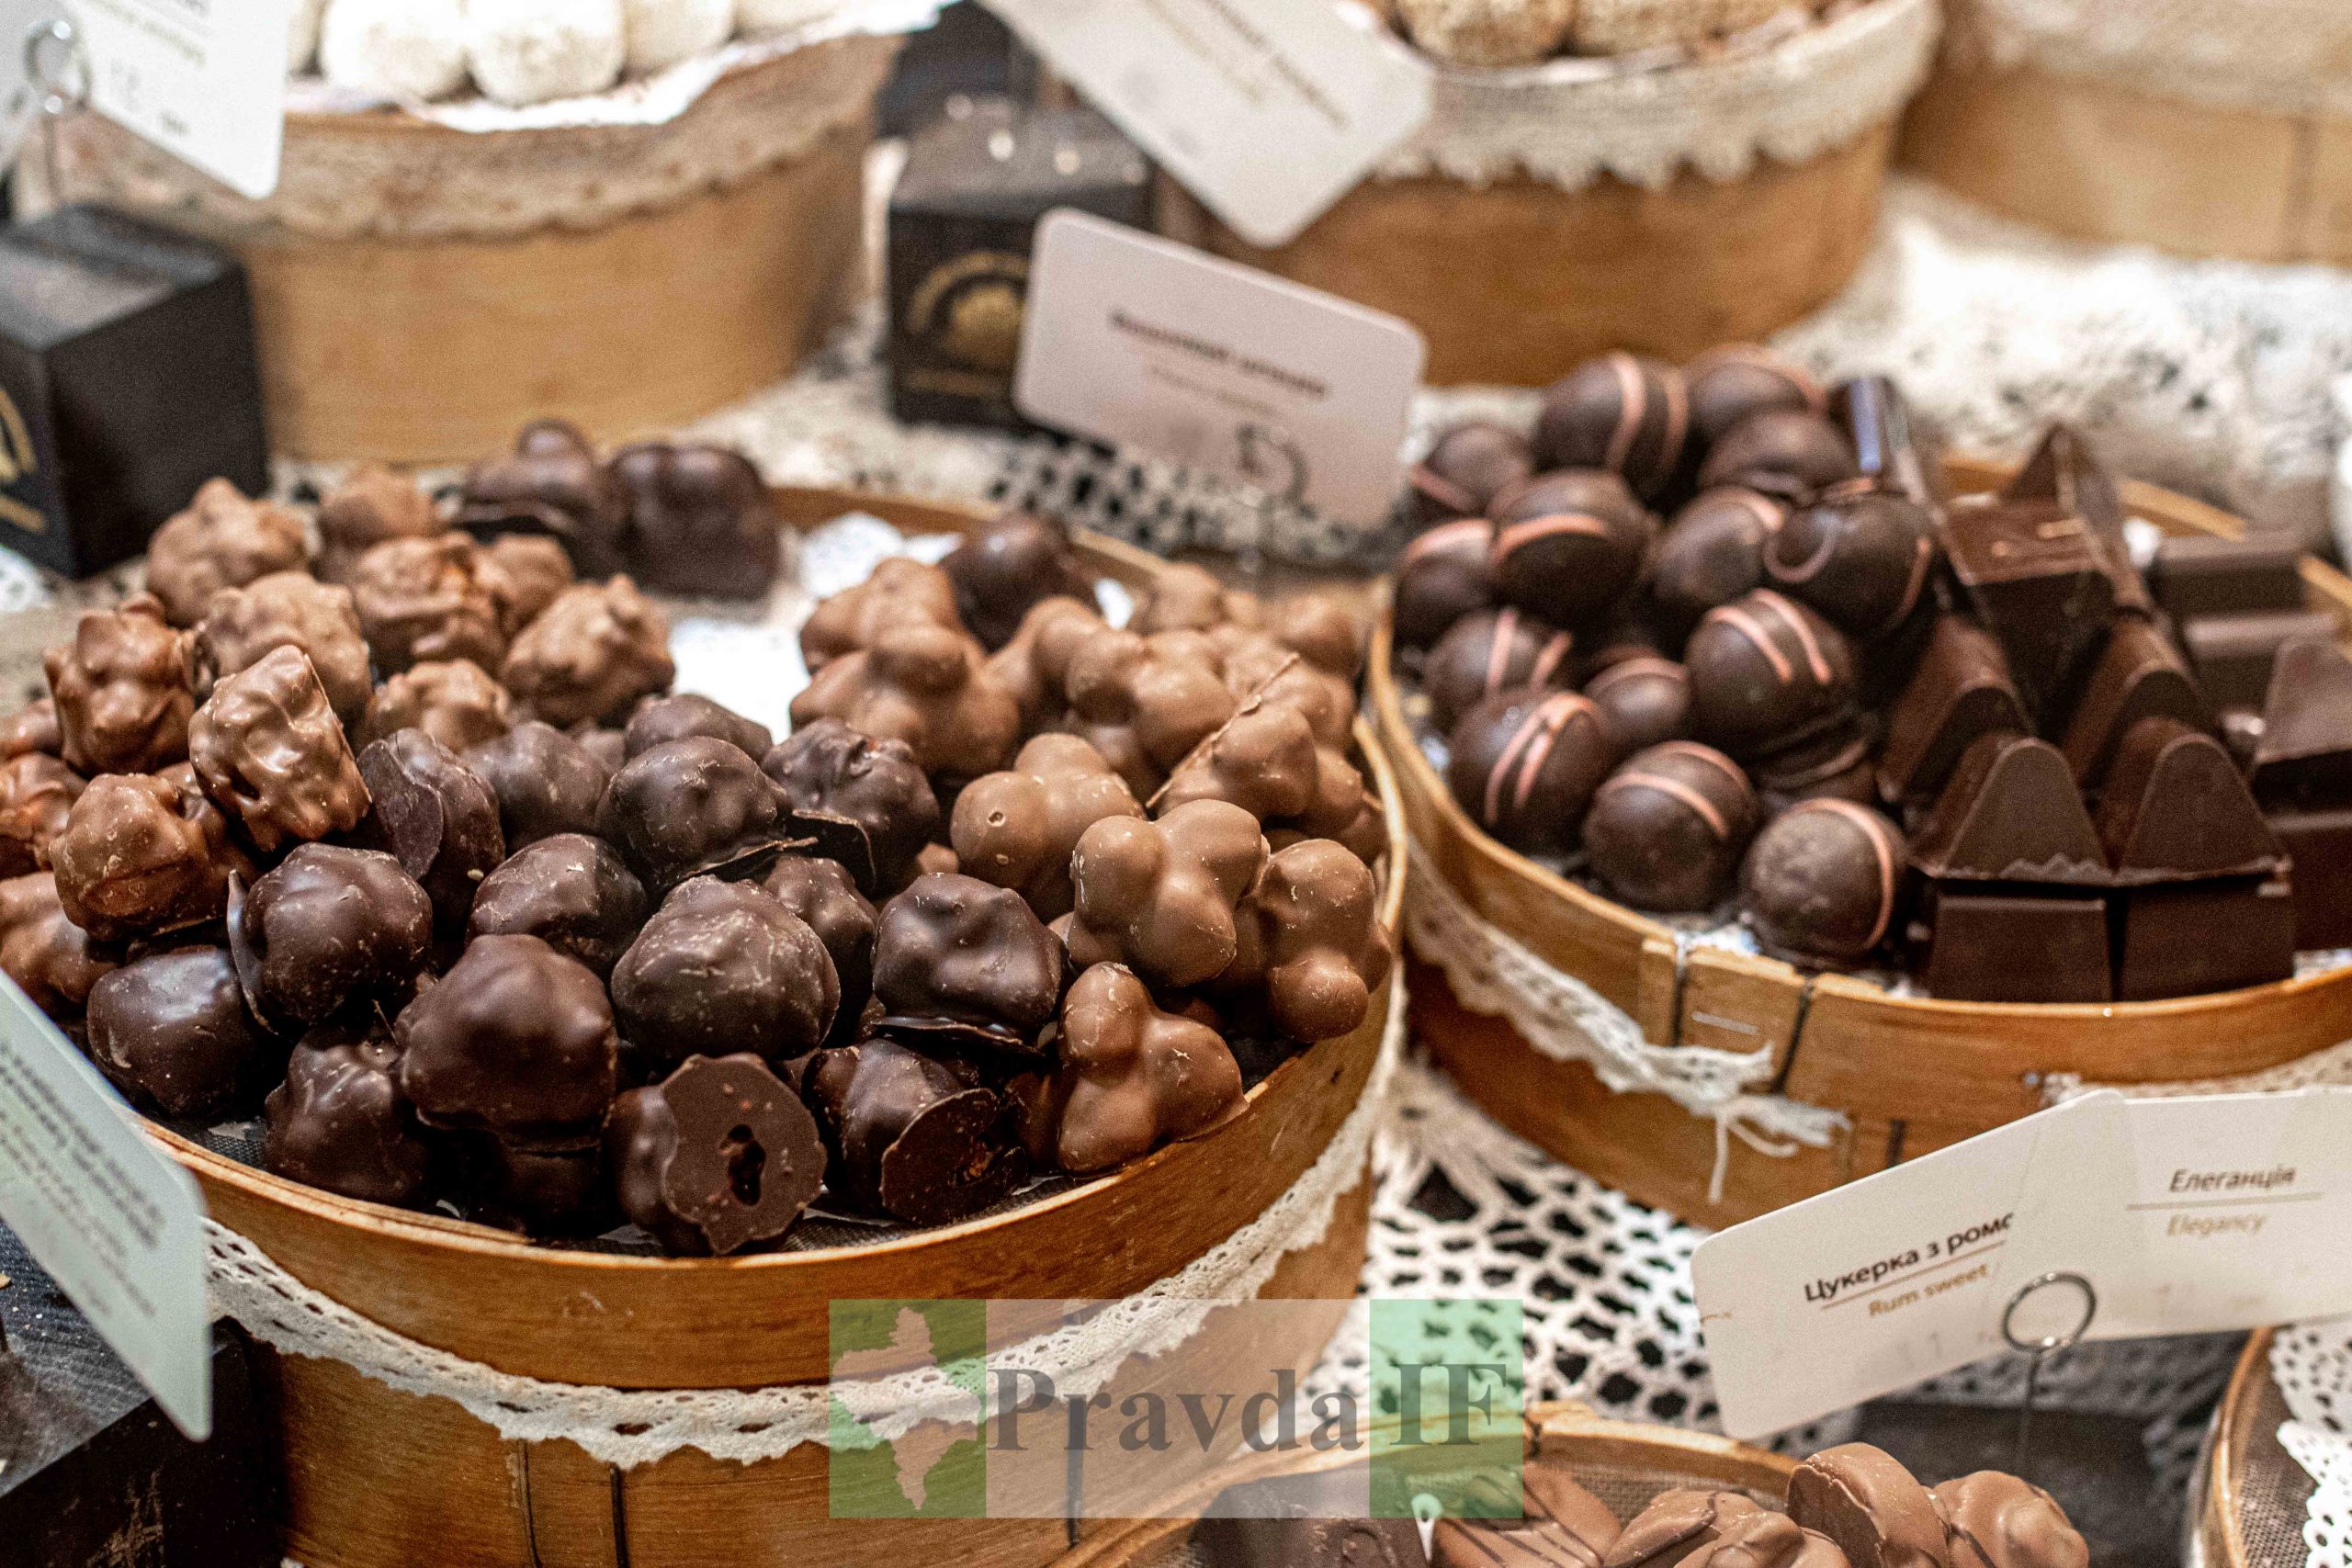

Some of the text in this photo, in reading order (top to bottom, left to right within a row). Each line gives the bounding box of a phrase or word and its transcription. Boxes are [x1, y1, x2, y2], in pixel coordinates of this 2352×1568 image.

[2169, 1164, 2296, 1192] Елеганція
[2165, 1214, 2267, 1237] Elegancy
[1804, 1249, 1919, 1301] Цукерка
[1927, 1241, 1940, 1258] з
[1868, 1264, 1989, 1315] Rum sweet
